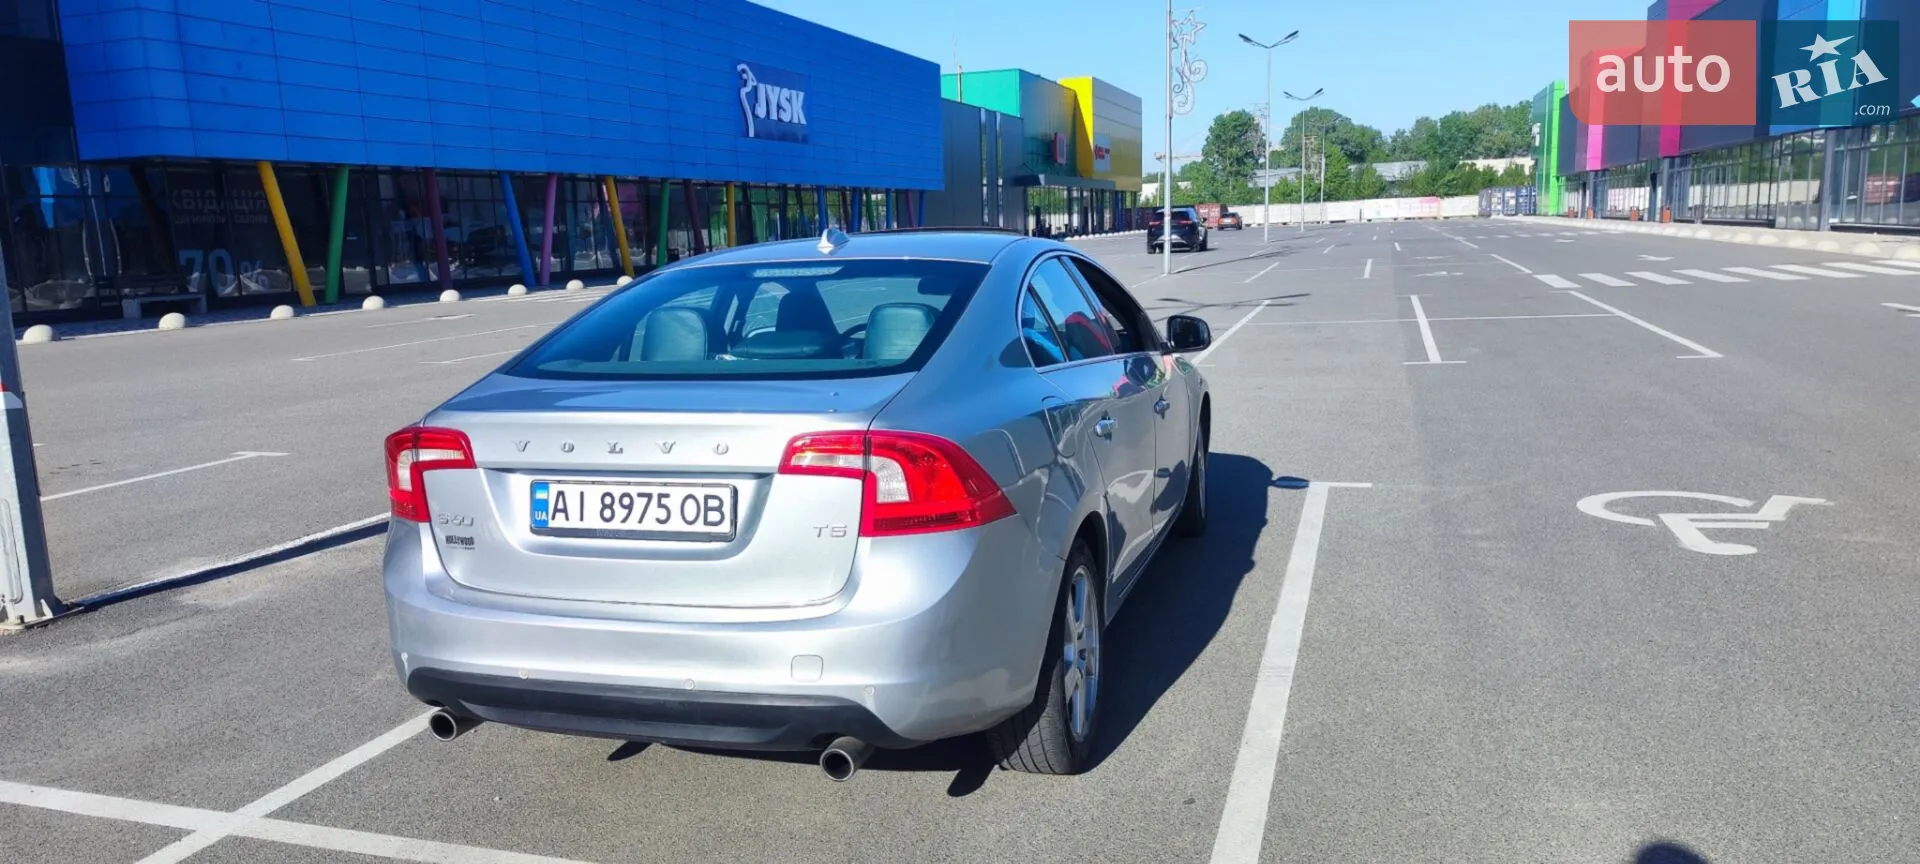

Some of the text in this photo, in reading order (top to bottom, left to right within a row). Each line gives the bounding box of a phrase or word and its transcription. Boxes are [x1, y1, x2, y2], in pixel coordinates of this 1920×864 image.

[754, 82, 808, 125] JYSK
[512, 440, 729, 455] VOLVO
[535, 511, 548, 521] UA
[551, 490, 726, 527] AI 8975 OB
[813, 523, 848, 538] T5
